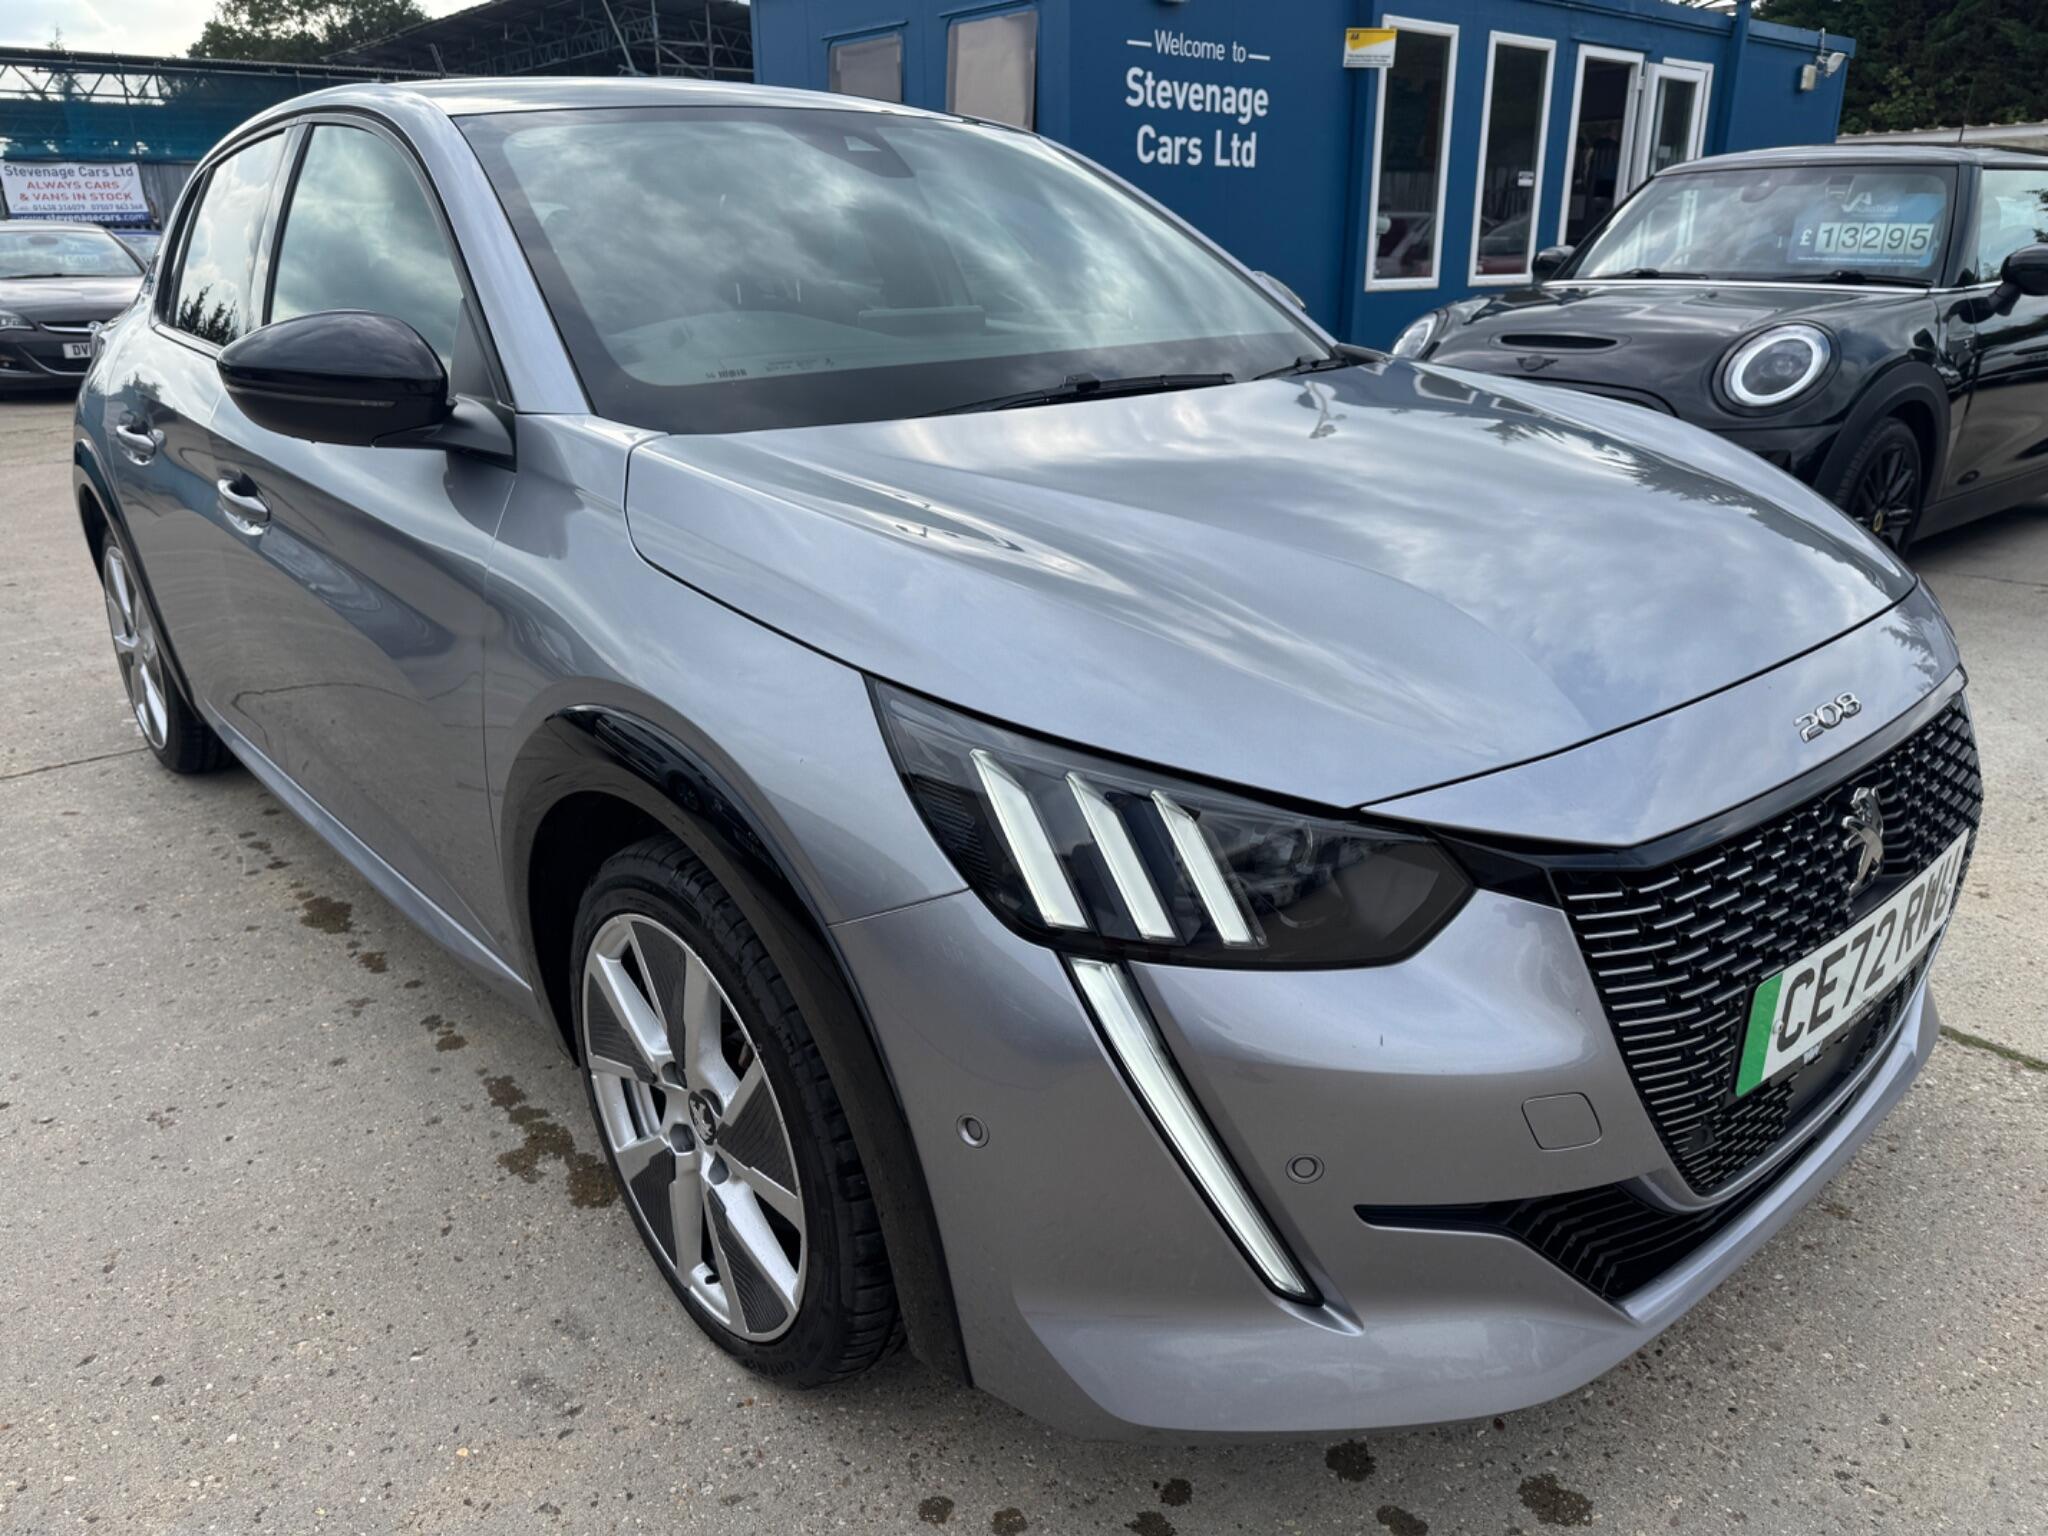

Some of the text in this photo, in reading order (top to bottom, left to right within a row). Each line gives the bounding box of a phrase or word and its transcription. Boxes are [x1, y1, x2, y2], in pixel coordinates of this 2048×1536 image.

[1154, 29, 1247, 64] Welcome to
[1125, 66, 1270, 125] Stevenage
[1136, 124, 1258, 168] Cars Ltd
[4, 165, 134, 179] Stevenage Cars Ltd
[27, 180, 120, 190] ALWAYS CARS
[19, 192, 134, 201] & VANS IN STOCK
[1794, 691, 1862, 743] 208
[1776, 845, 1962, 1054] CE72 RWU
